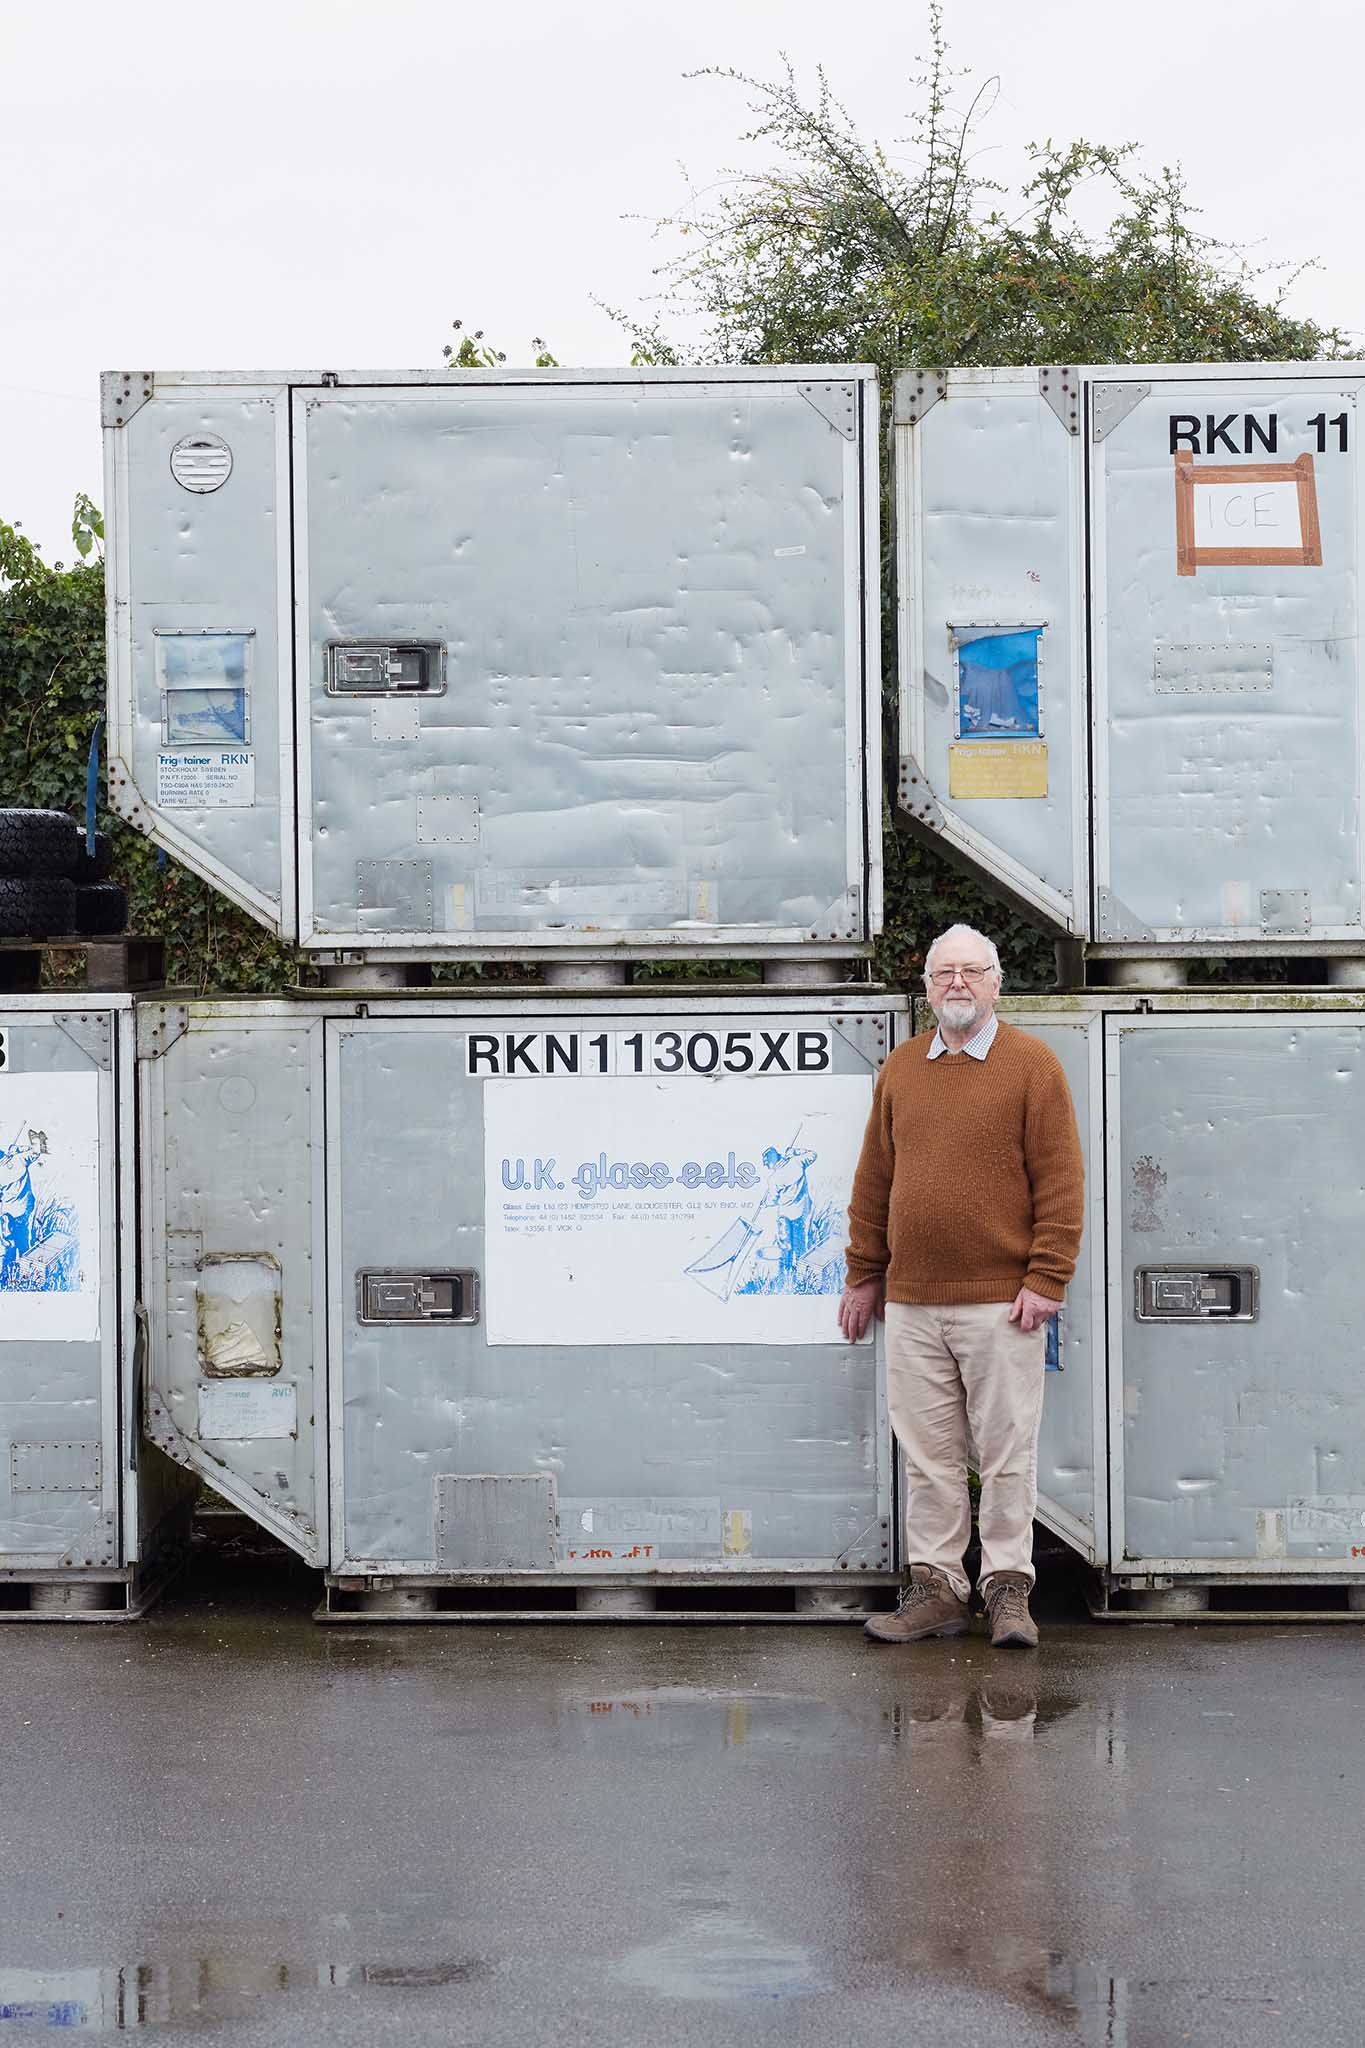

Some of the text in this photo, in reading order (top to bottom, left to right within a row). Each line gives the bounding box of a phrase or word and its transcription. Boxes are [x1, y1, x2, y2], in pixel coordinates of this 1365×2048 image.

[1169, 413, 1348, 455] RKN 11
[1208, 492, 1281, 529] ICE
[221, 754, 249, 765] RKN
[468, 1032, 830, 1074] RKN11305XB
[501, 1151, 761, 1200] U.K. glass eels
